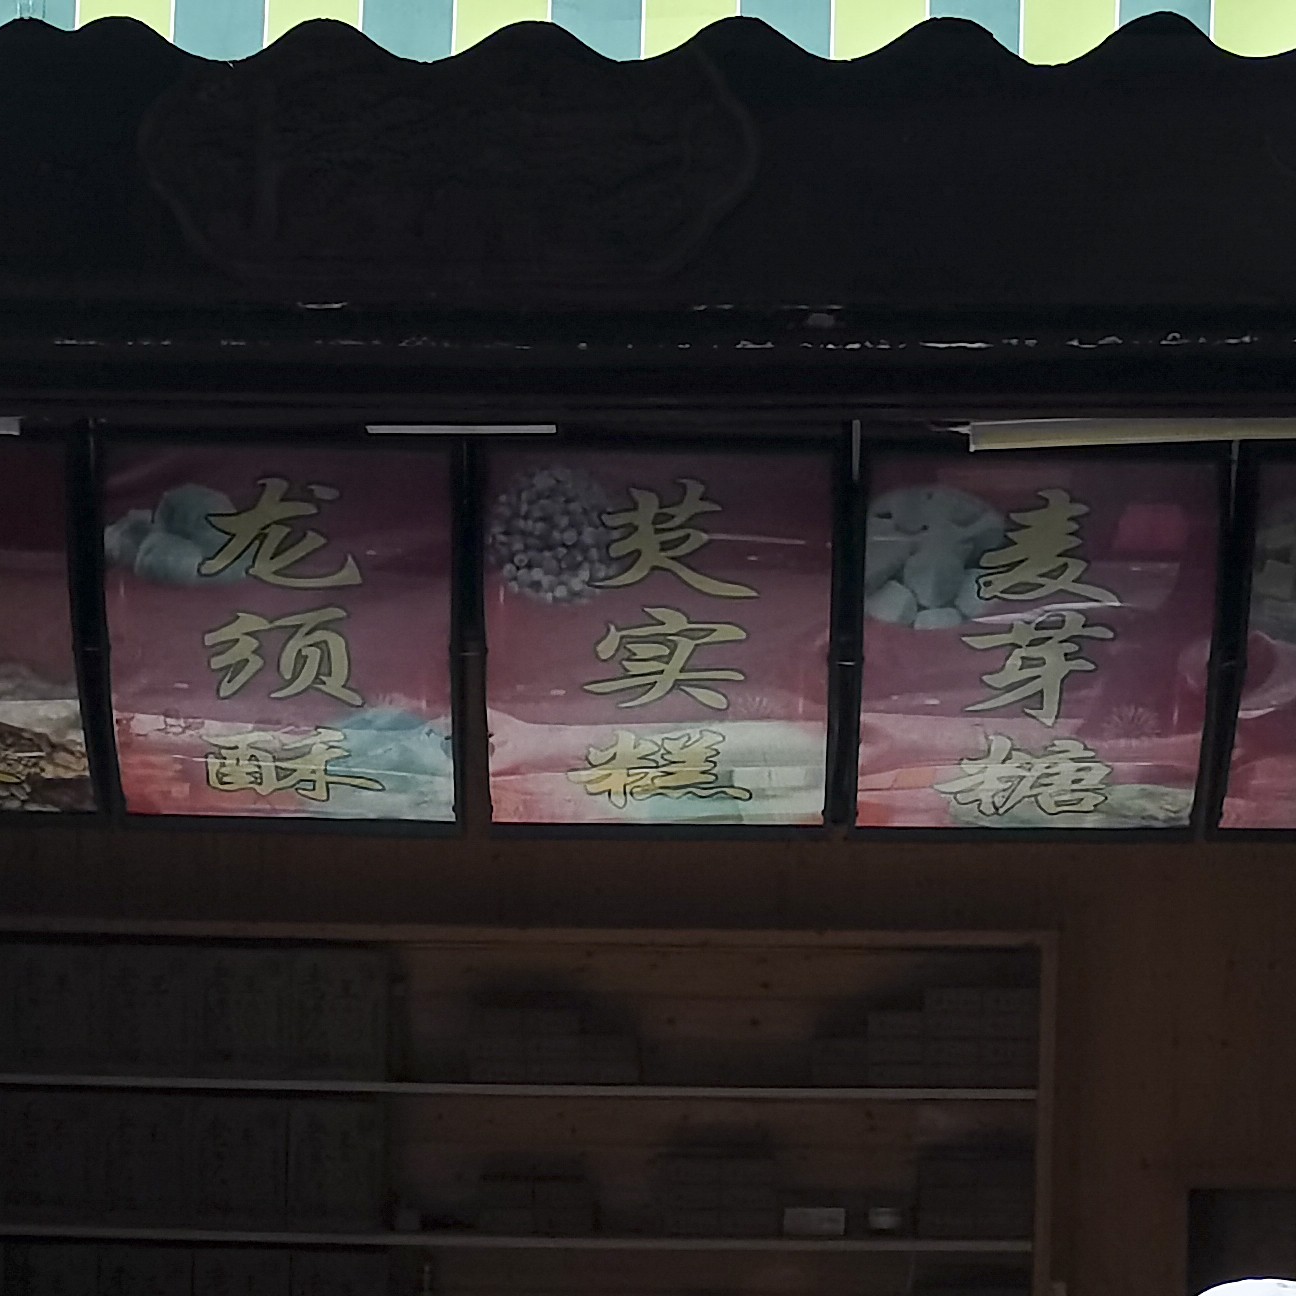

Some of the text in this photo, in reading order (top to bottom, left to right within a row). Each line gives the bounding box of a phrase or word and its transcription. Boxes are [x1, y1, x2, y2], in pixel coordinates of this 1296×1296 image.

[195, 476, 385, 803] 龙须酥
[568, 476, 759, 809] 芡实糕
[932, 487, 1124, 815] 麦芽糖
